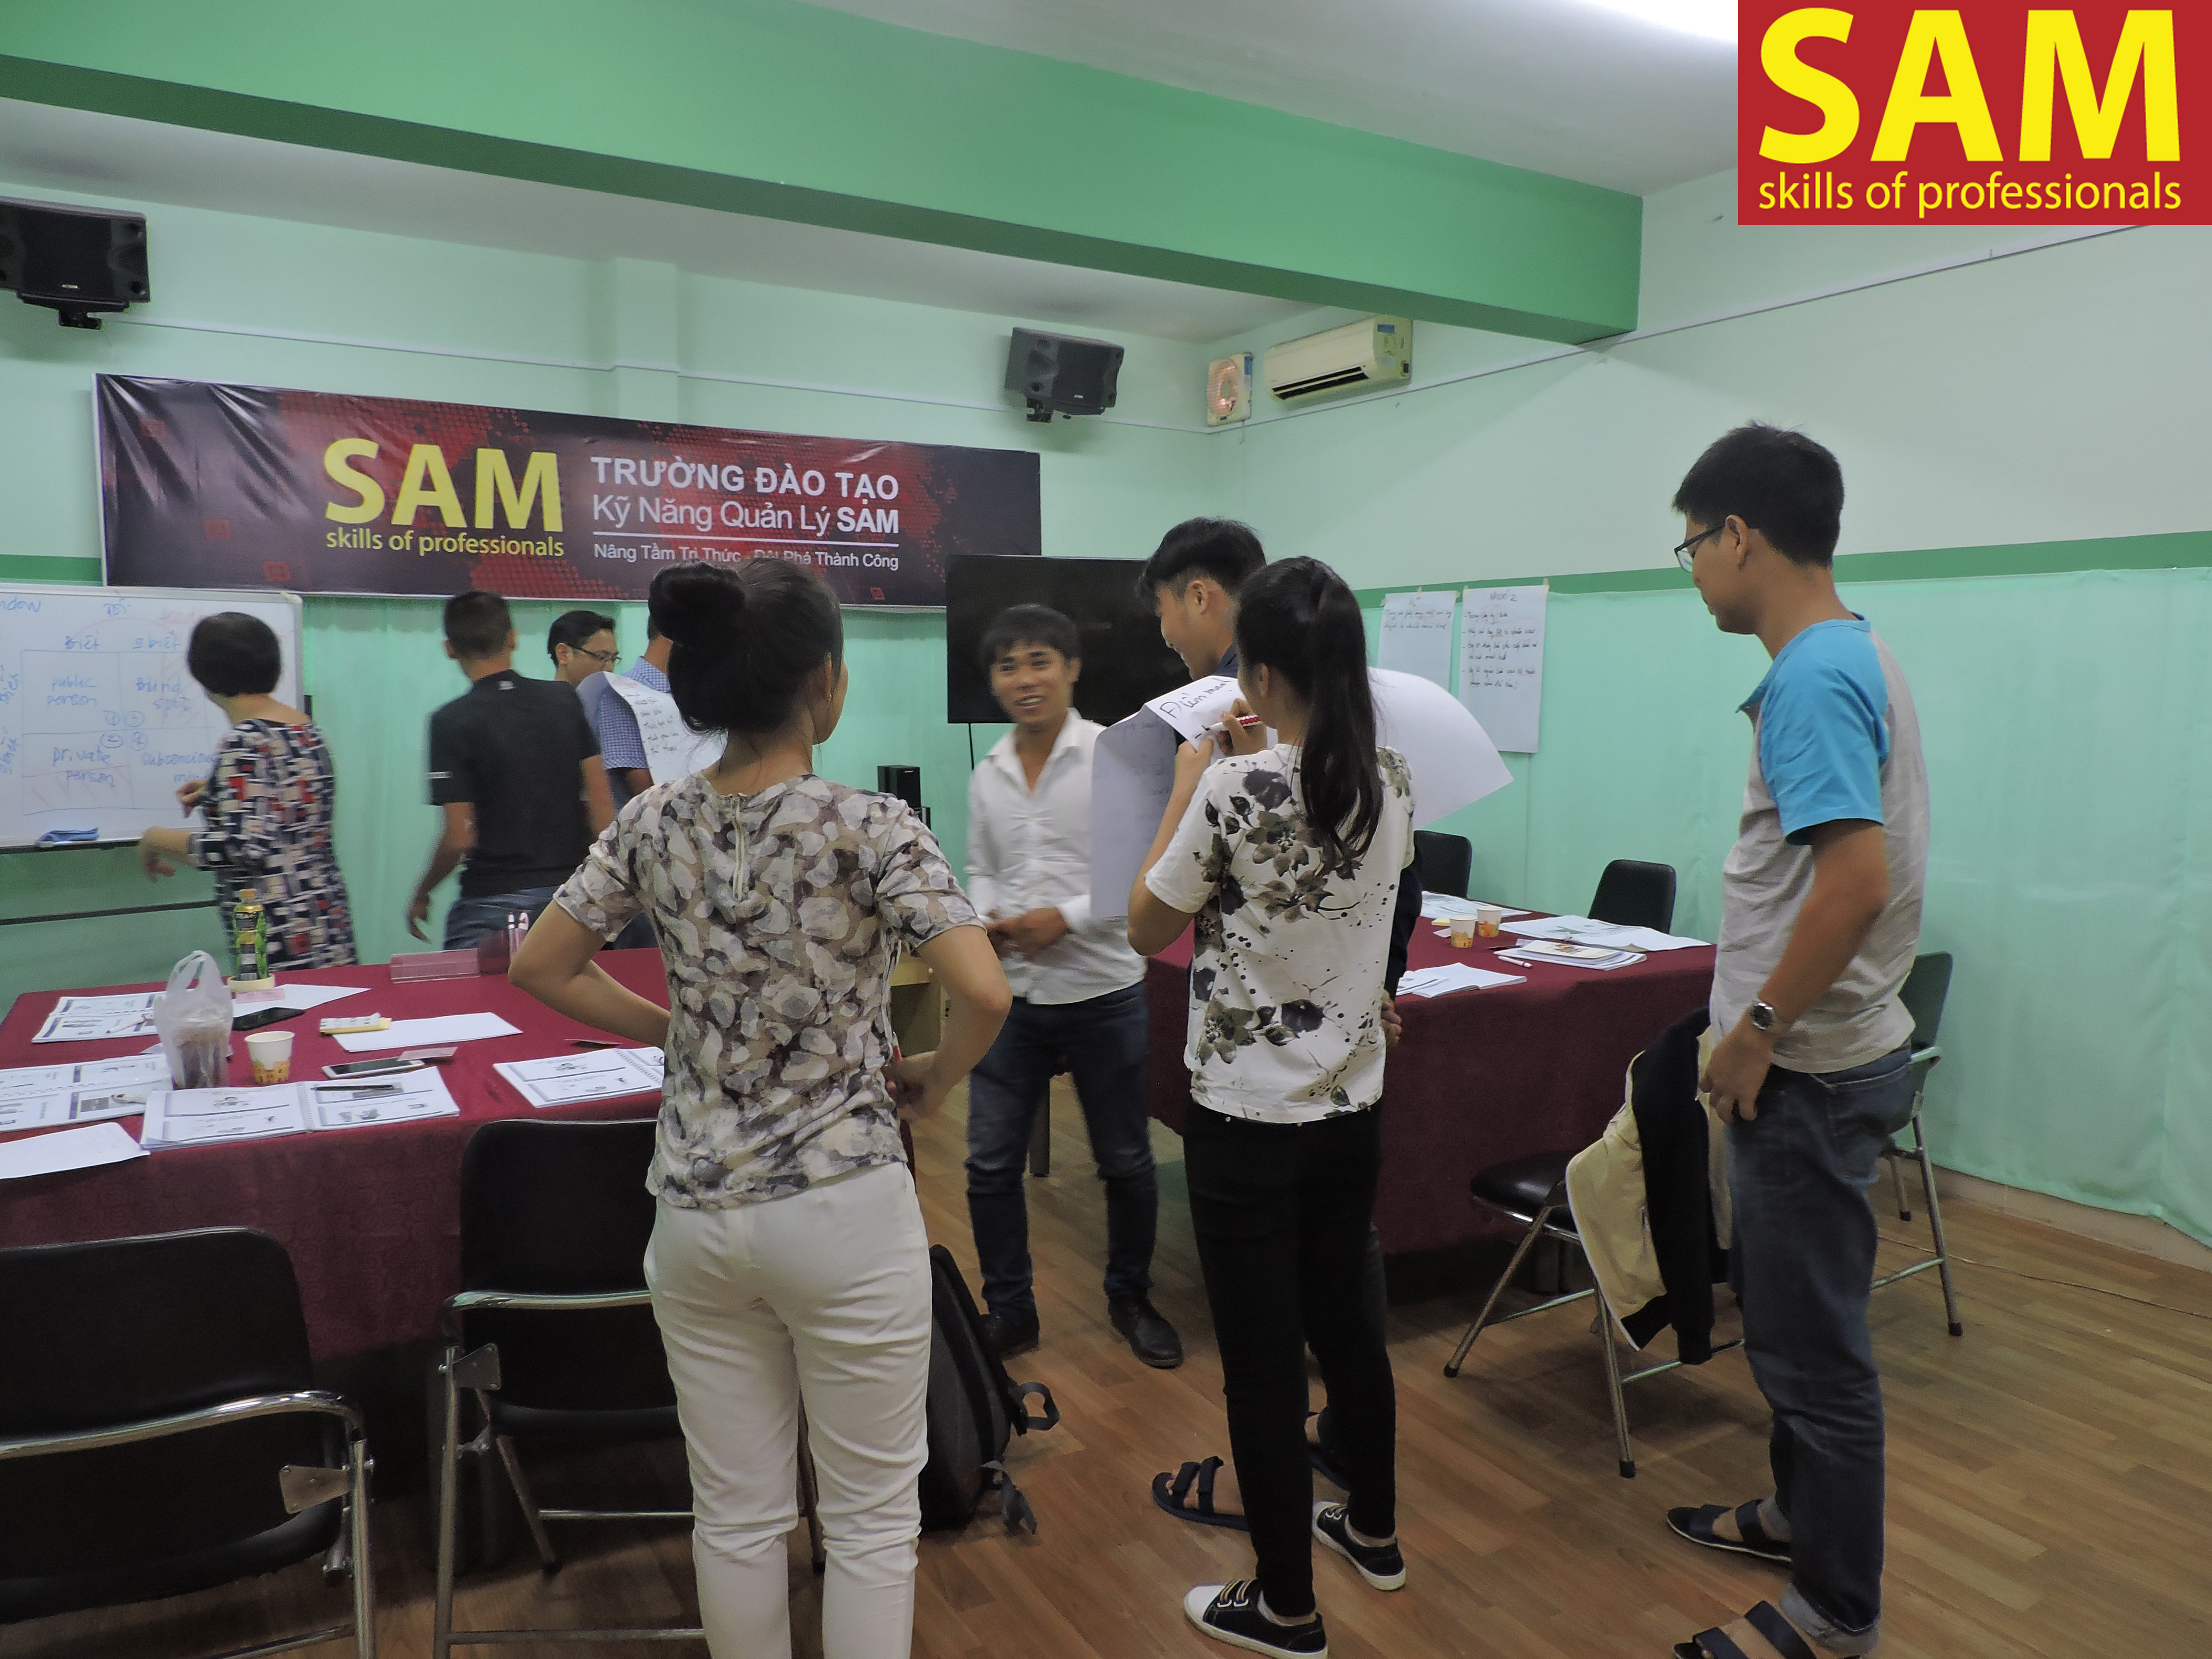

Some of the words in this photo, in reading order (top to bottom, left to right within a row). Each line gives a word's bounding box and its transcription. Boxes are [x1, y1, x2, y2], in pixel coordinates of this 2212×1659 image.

[324, 437, 563, 532] SAM
[590, 456, 745, 492] TRƯỜNG
[754, 463, 826, 496] ĐÀO
[834, 471, 899, 505] TẠO
[592, 494, 631, 529] Kỹ
[638, 496, 713, 532] Năng
[720, 501, 793, 529] Quản
[800, 505, 831, 537] Lý
[836, 506, 899, 534] SAM
[326, 528, 383, 550] skills
[389, 530, 413, 551] of
[419, 532, 565, 557] professionals
[593, 543, 637, 563] Nâng
[702, 547, 741, 563] Thức
[815, 551, 859, 566] Thành
[862, 553, 899, 571] Công
